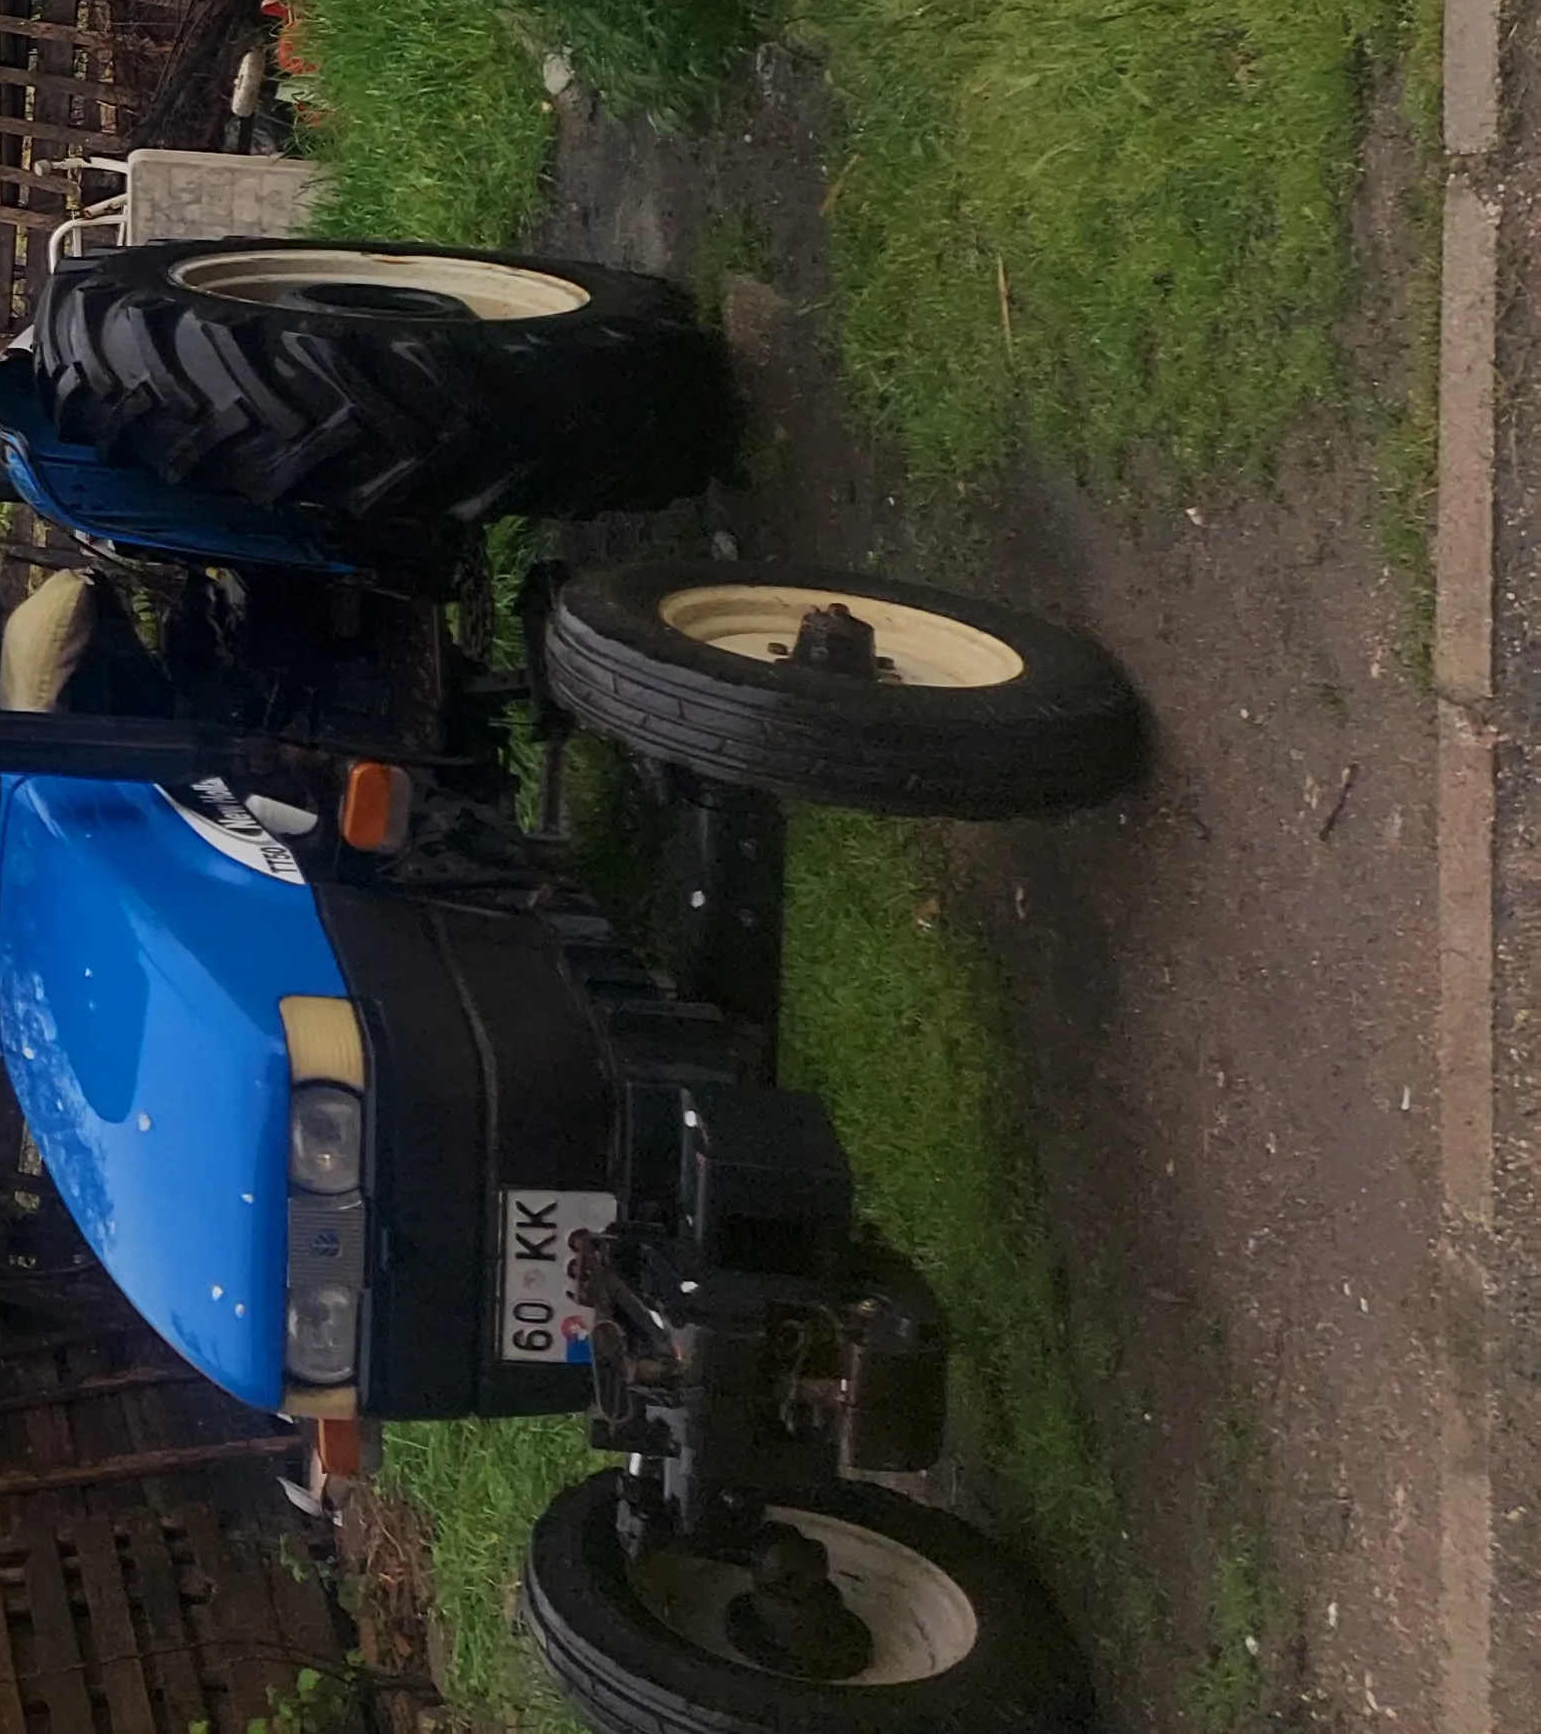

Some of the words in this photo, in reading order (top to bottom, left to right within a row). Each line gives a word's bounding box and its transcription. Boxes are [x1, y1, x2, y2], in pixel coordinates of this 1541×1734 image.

[189, 776, 239, 804] Holla
[216, 804, 263, 830] New
[260, 846, 297, 873] TT50
[515, 1200, 558, 1261] KK
[512, 1300, 554, 1352] 60
